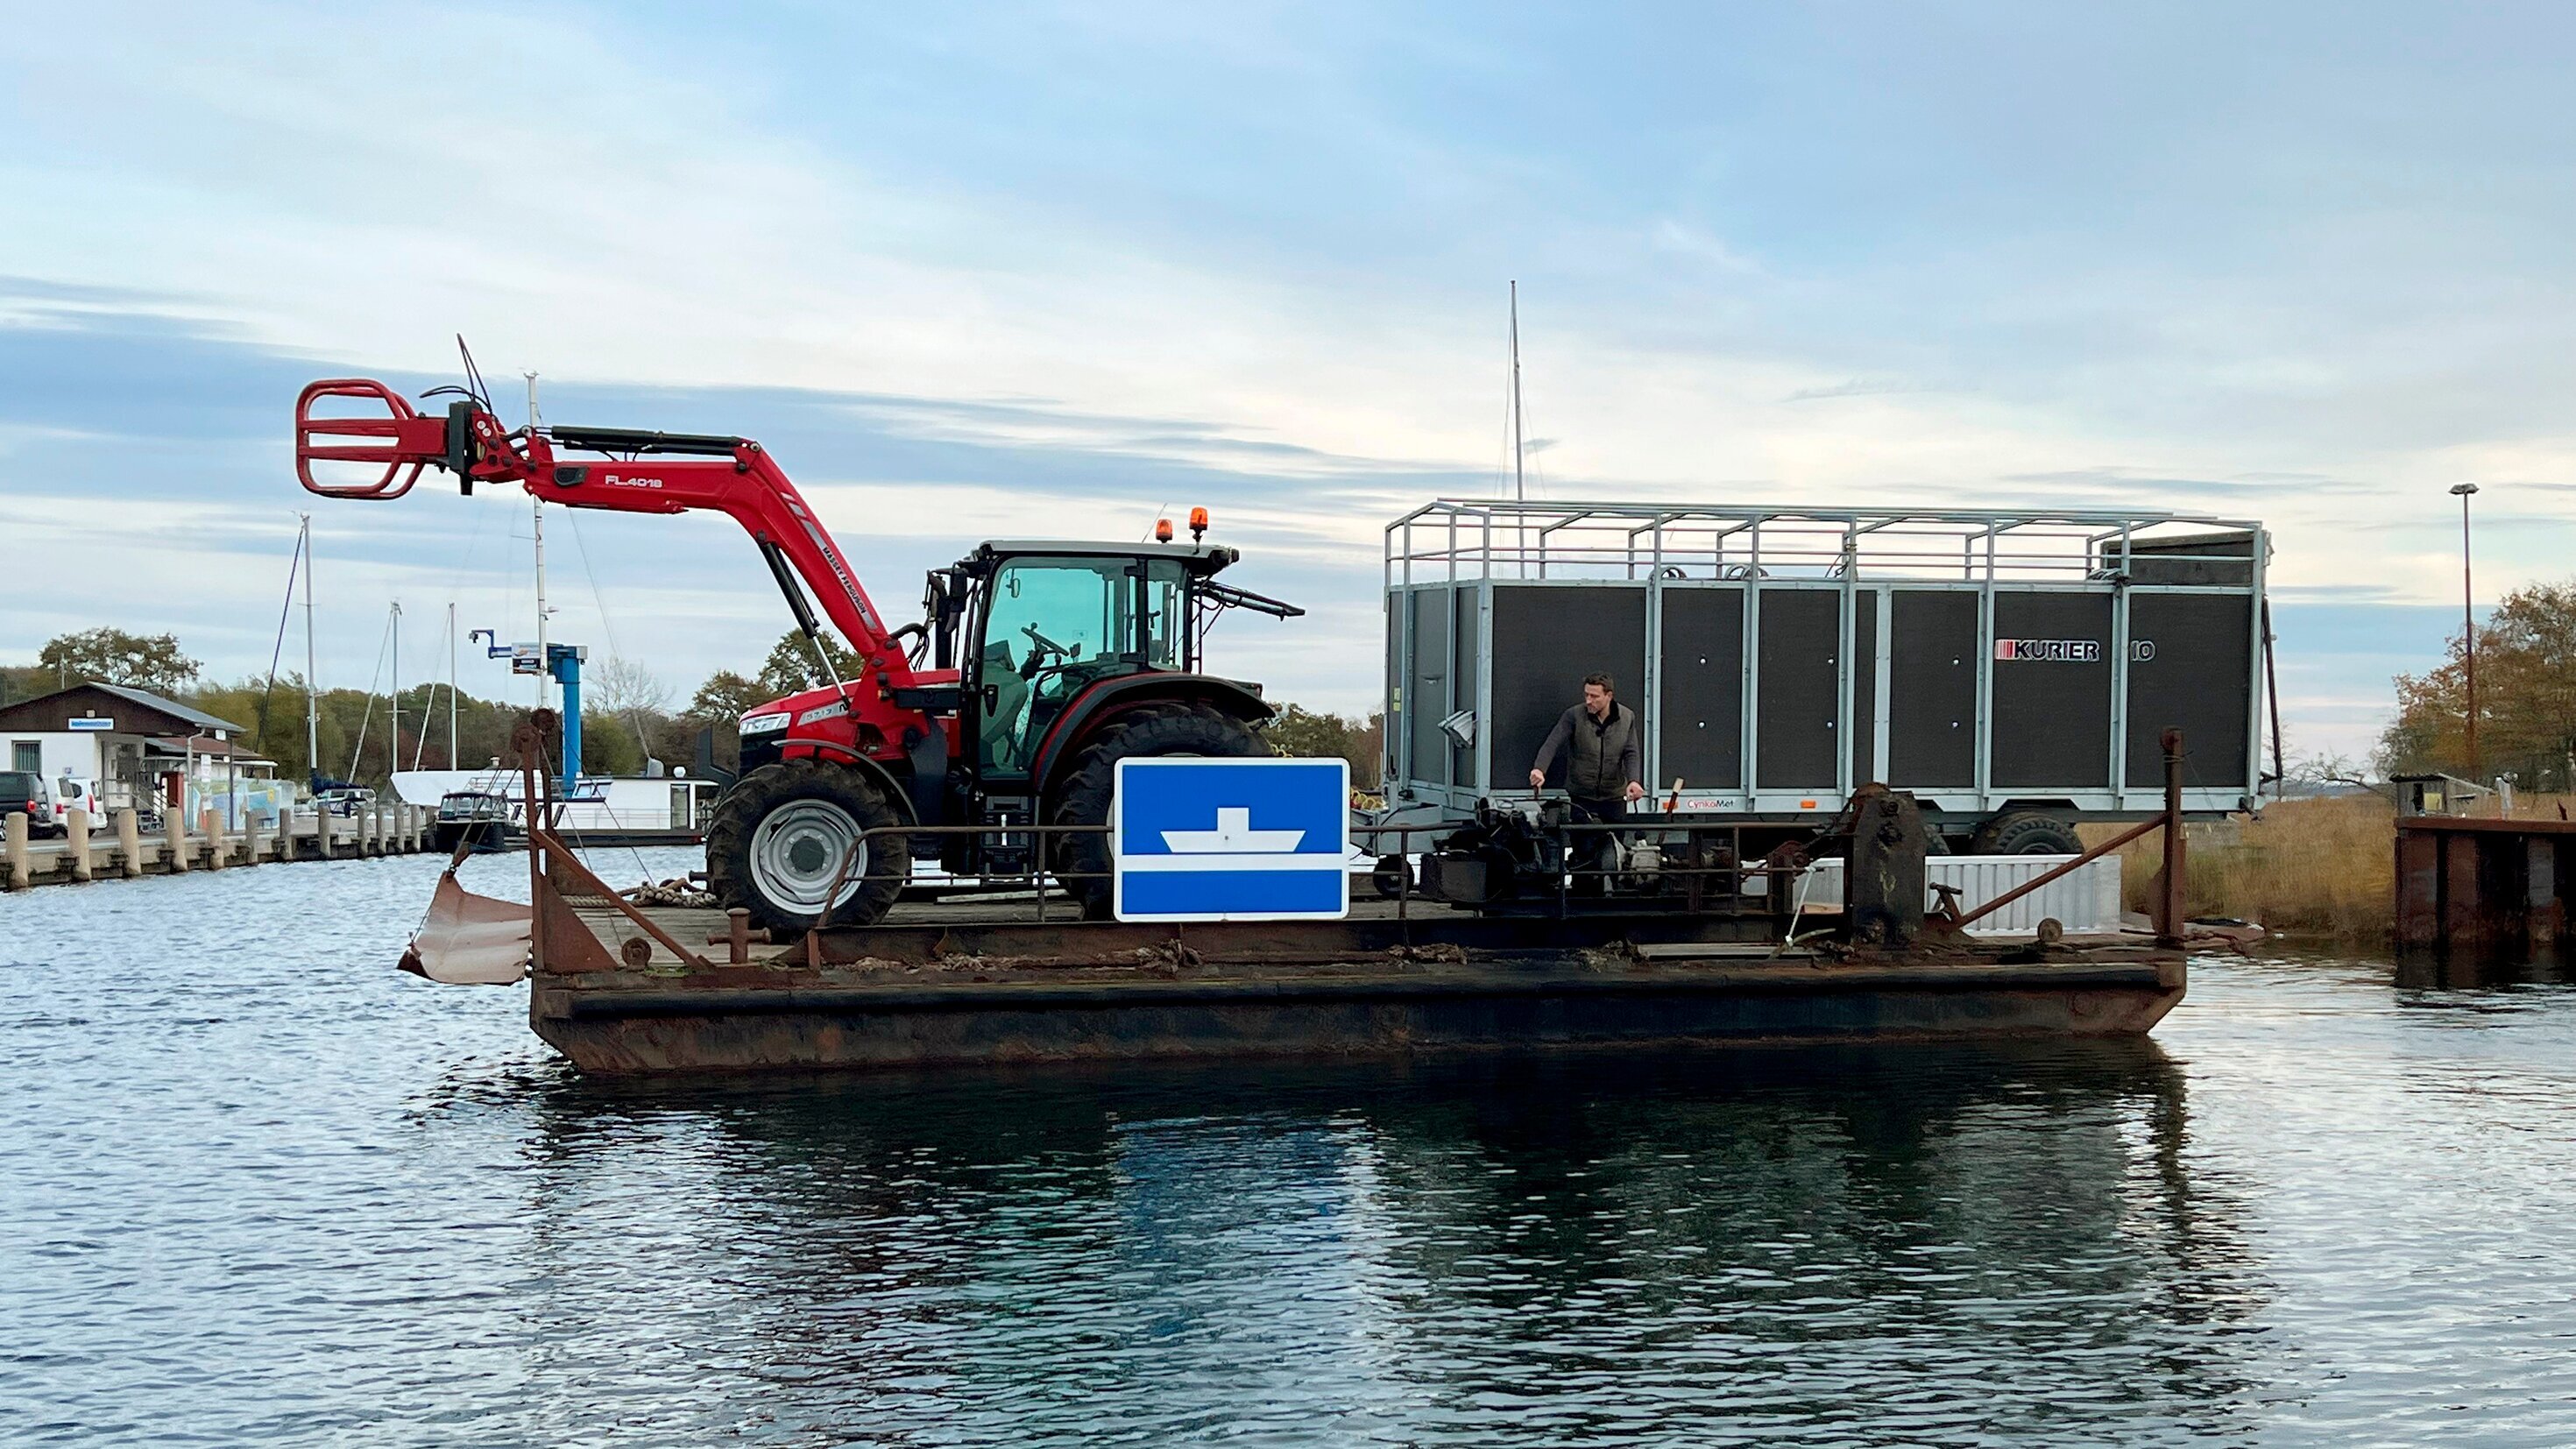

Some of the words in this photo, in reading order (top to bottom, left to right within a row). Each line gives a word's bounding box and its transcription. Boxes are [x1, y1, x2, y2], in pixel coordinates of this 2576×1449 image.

[841, 576, 867, 614] FERGUSON
[2014, 639, 2100, 661] KURIER
[2130, 640, 2156, 661] 10
